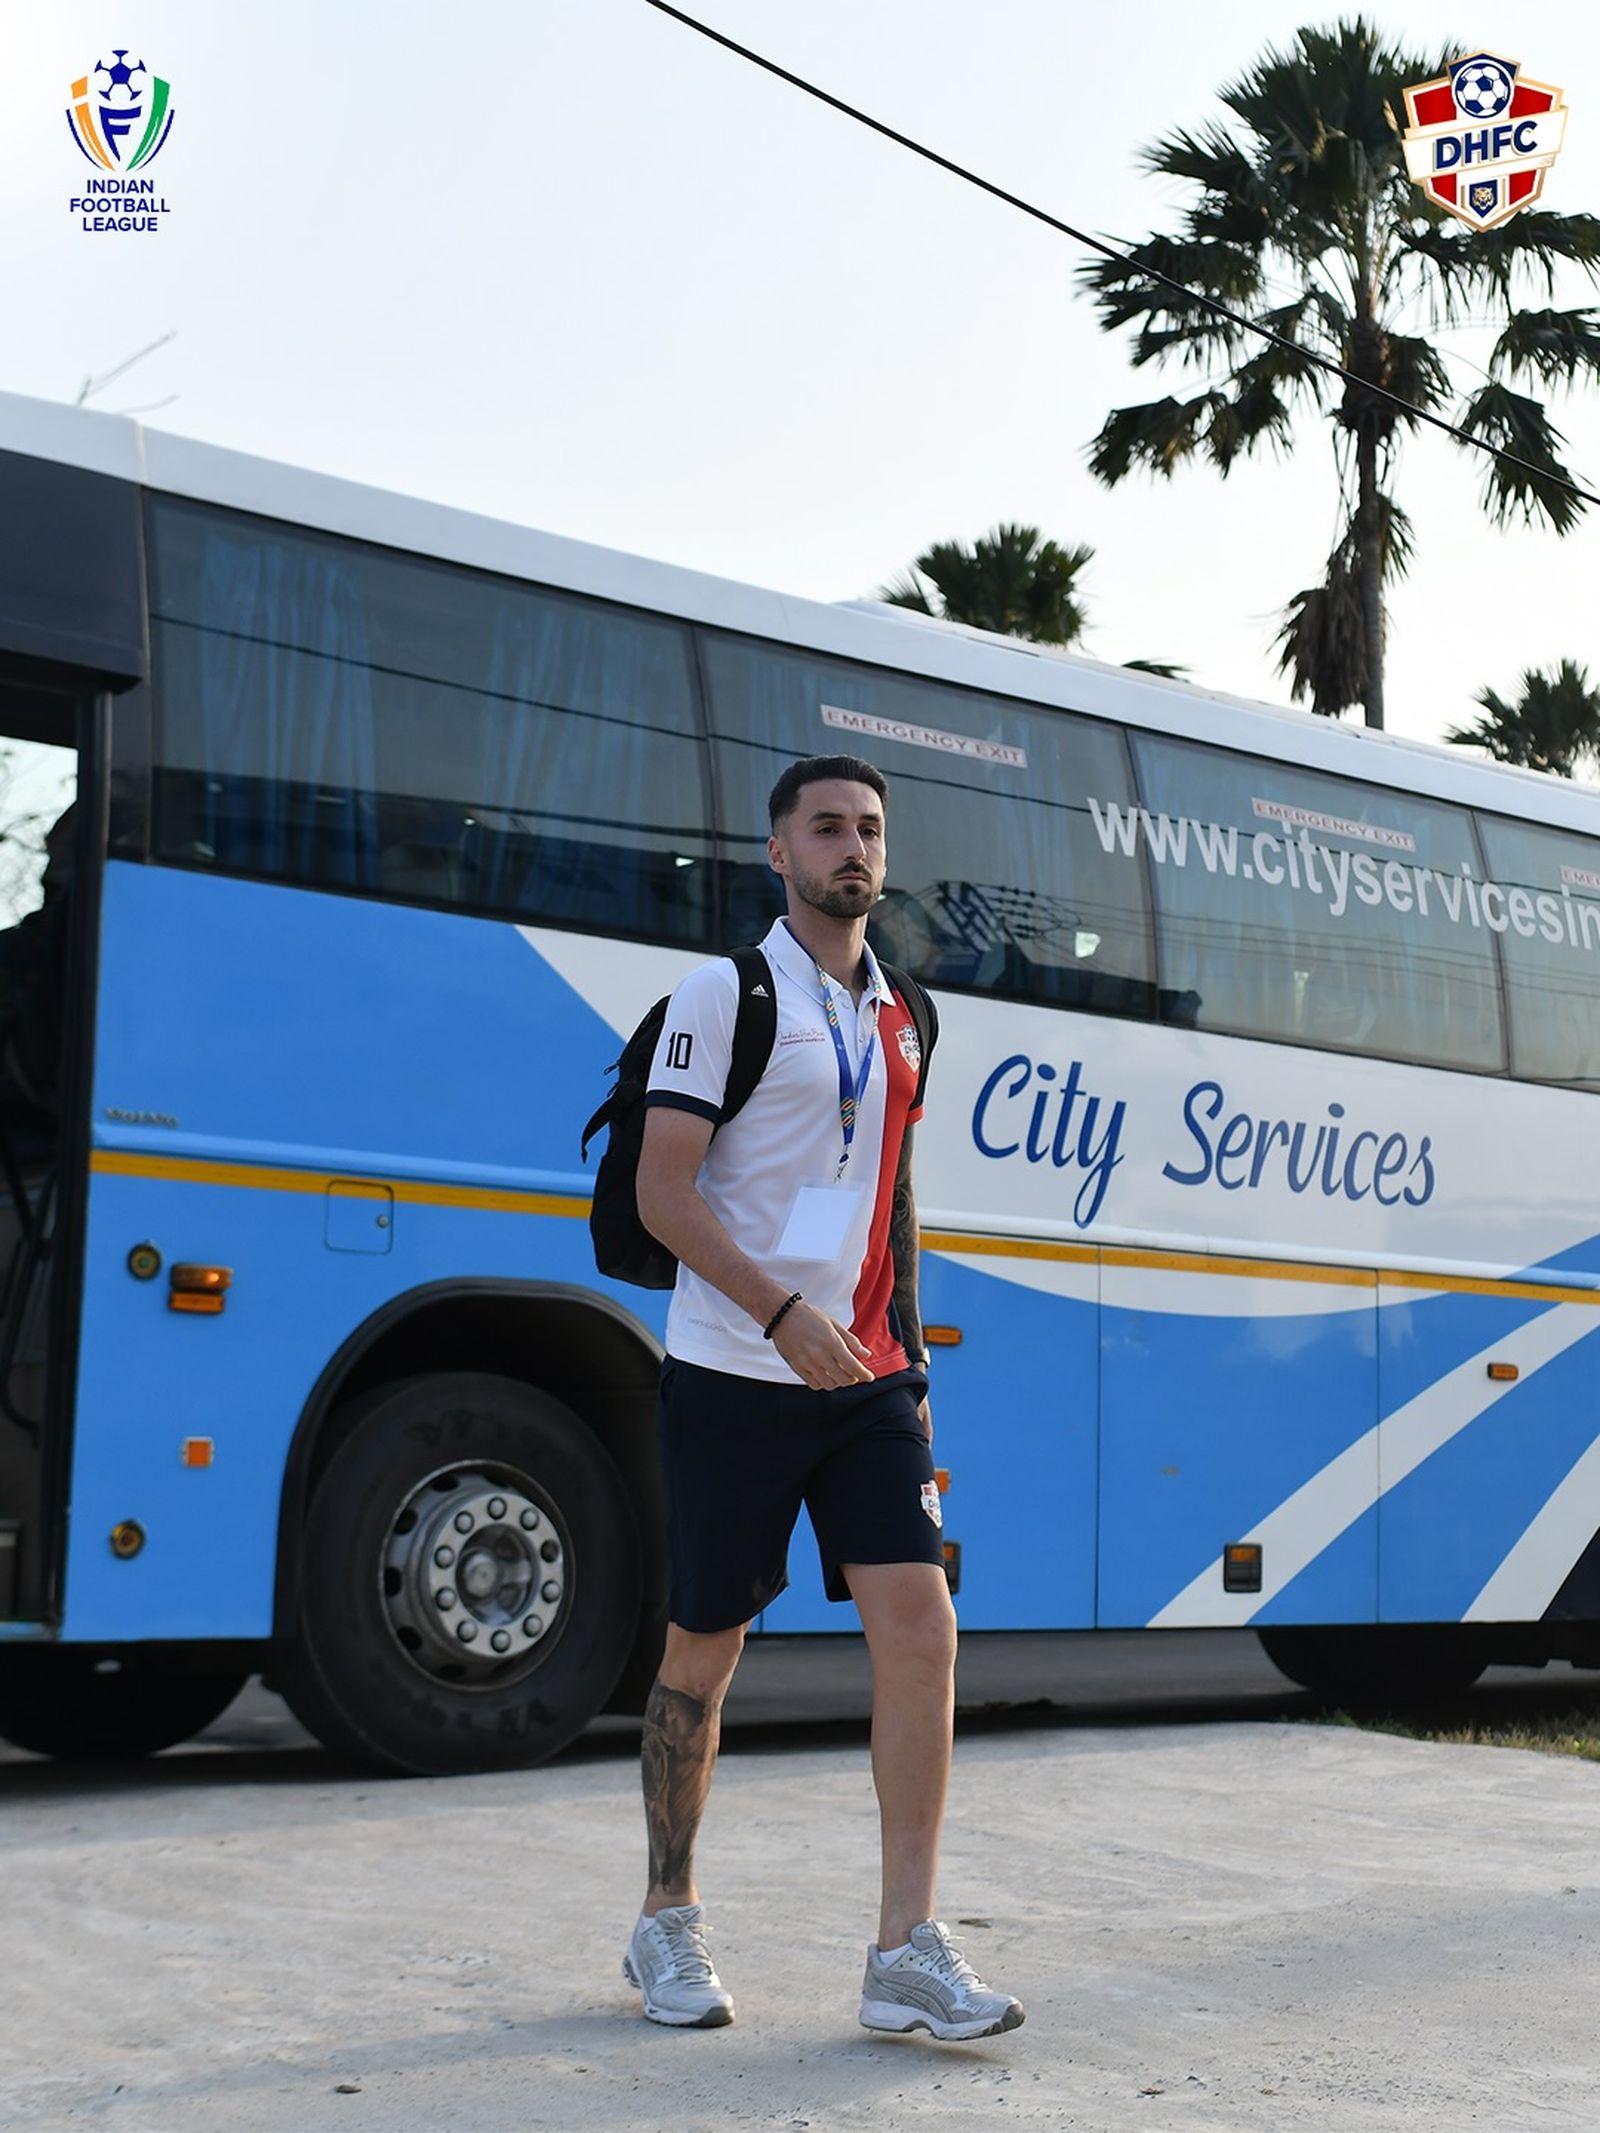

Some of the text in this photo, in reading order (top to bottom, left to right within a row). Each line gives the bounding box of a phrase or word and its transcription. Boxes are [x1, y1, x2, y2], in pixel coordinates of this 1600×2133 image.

[827, 710, 1021, 763] EMERGENCY EXIT
[1257, 804, 1410, 847] EMERGENCY EXIT
[665, 1031, 693, 1071] 10
[971, 1054, 1436, 1229] City Services
